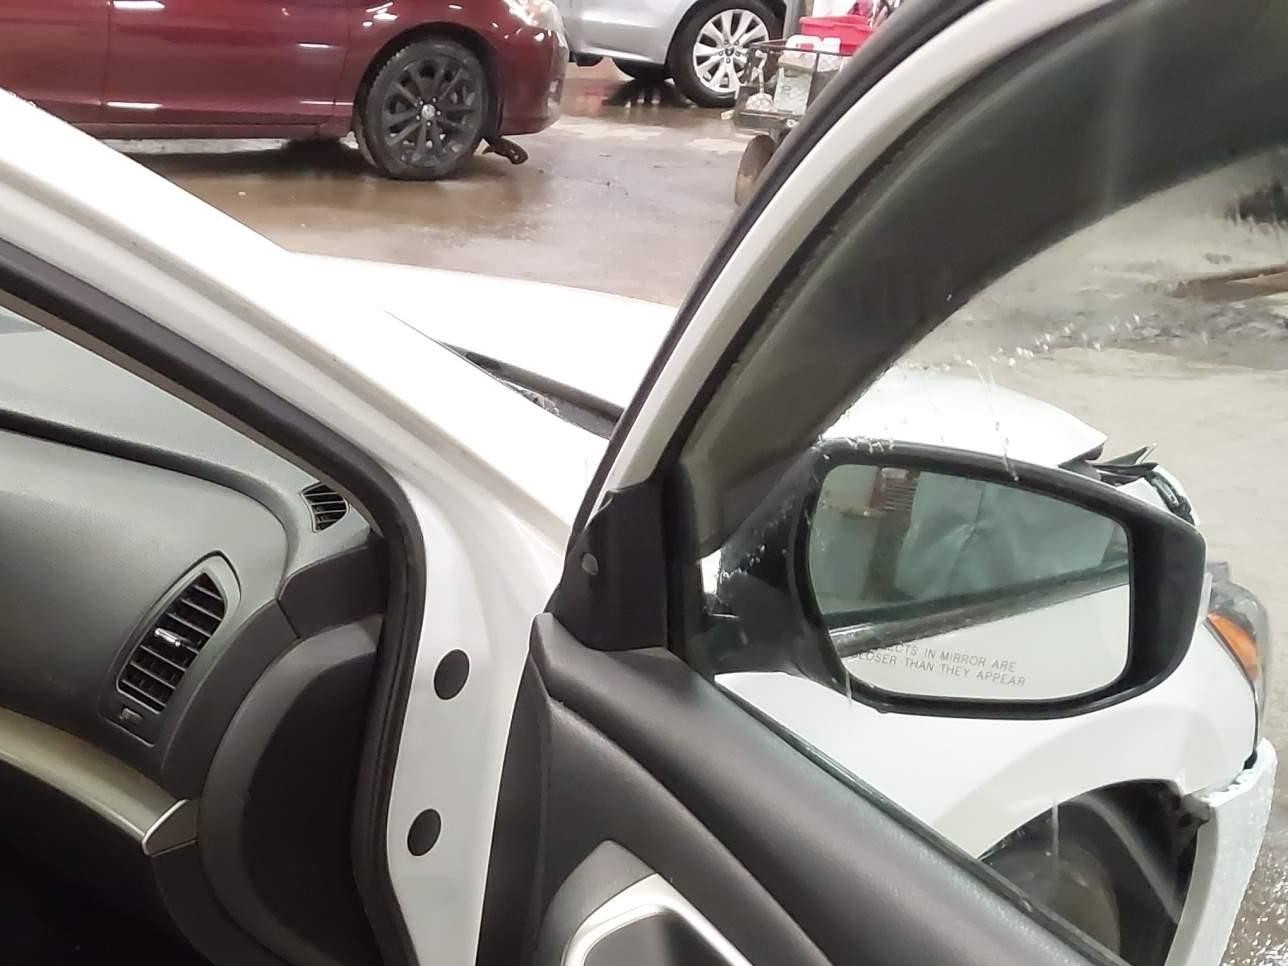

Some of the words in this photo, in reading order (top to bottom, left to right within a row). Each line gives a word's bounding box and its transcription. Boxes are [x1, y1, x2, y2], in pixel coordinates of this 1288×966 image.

[905, 658, 935, 672] THAN
[941, 664, 970, 678] THEY
[975, 671, 1026, 687] APPEAR
[924, 648, 936, 659] IN
[940, 651, 986, 667] MIRROR
[991, 660, 1016, 673] ARE
